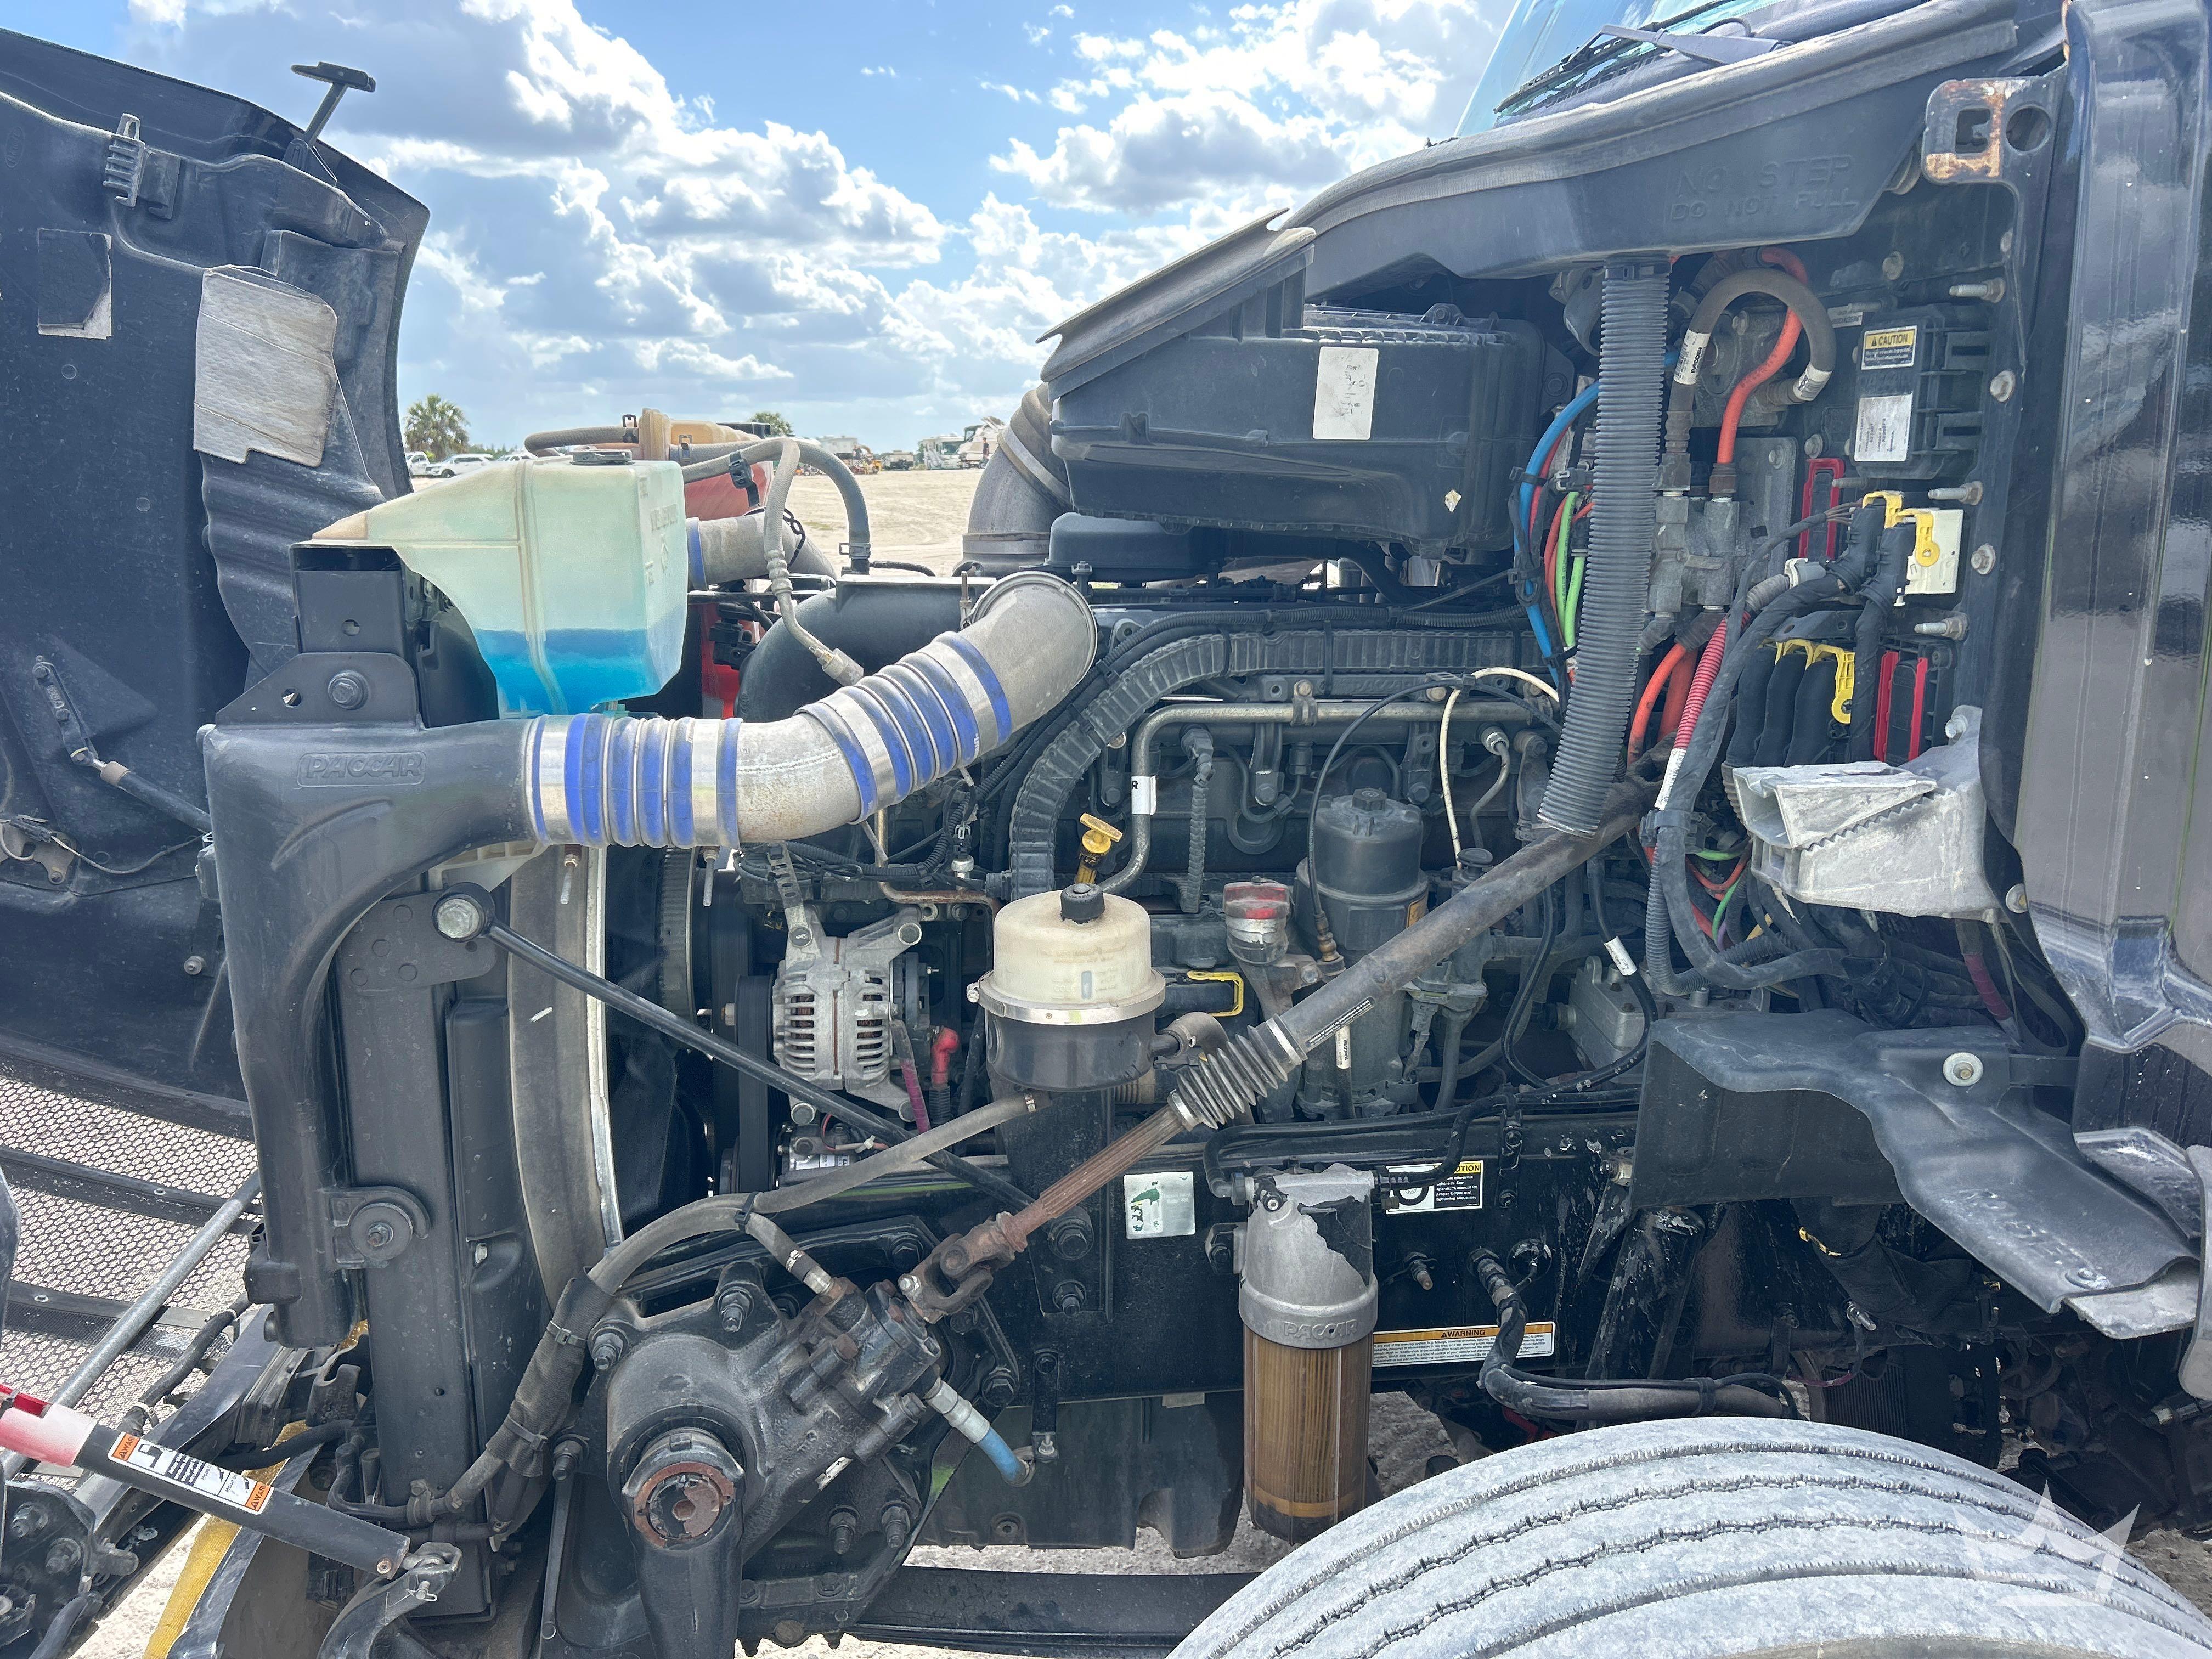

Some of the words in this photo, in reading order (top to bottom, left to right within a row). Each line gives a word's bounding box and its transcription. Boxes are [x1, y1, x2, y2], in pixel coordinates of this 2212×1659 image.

[1758, 154, 1853, 188] STEP
[1878, 333, 1908, 346] CAUTION
[306, 754, 423, 778] PACCAR
[1283, 1319, 1358, 1339] PACCAR
[1448, 1329, 1486, 1338] WARNING
